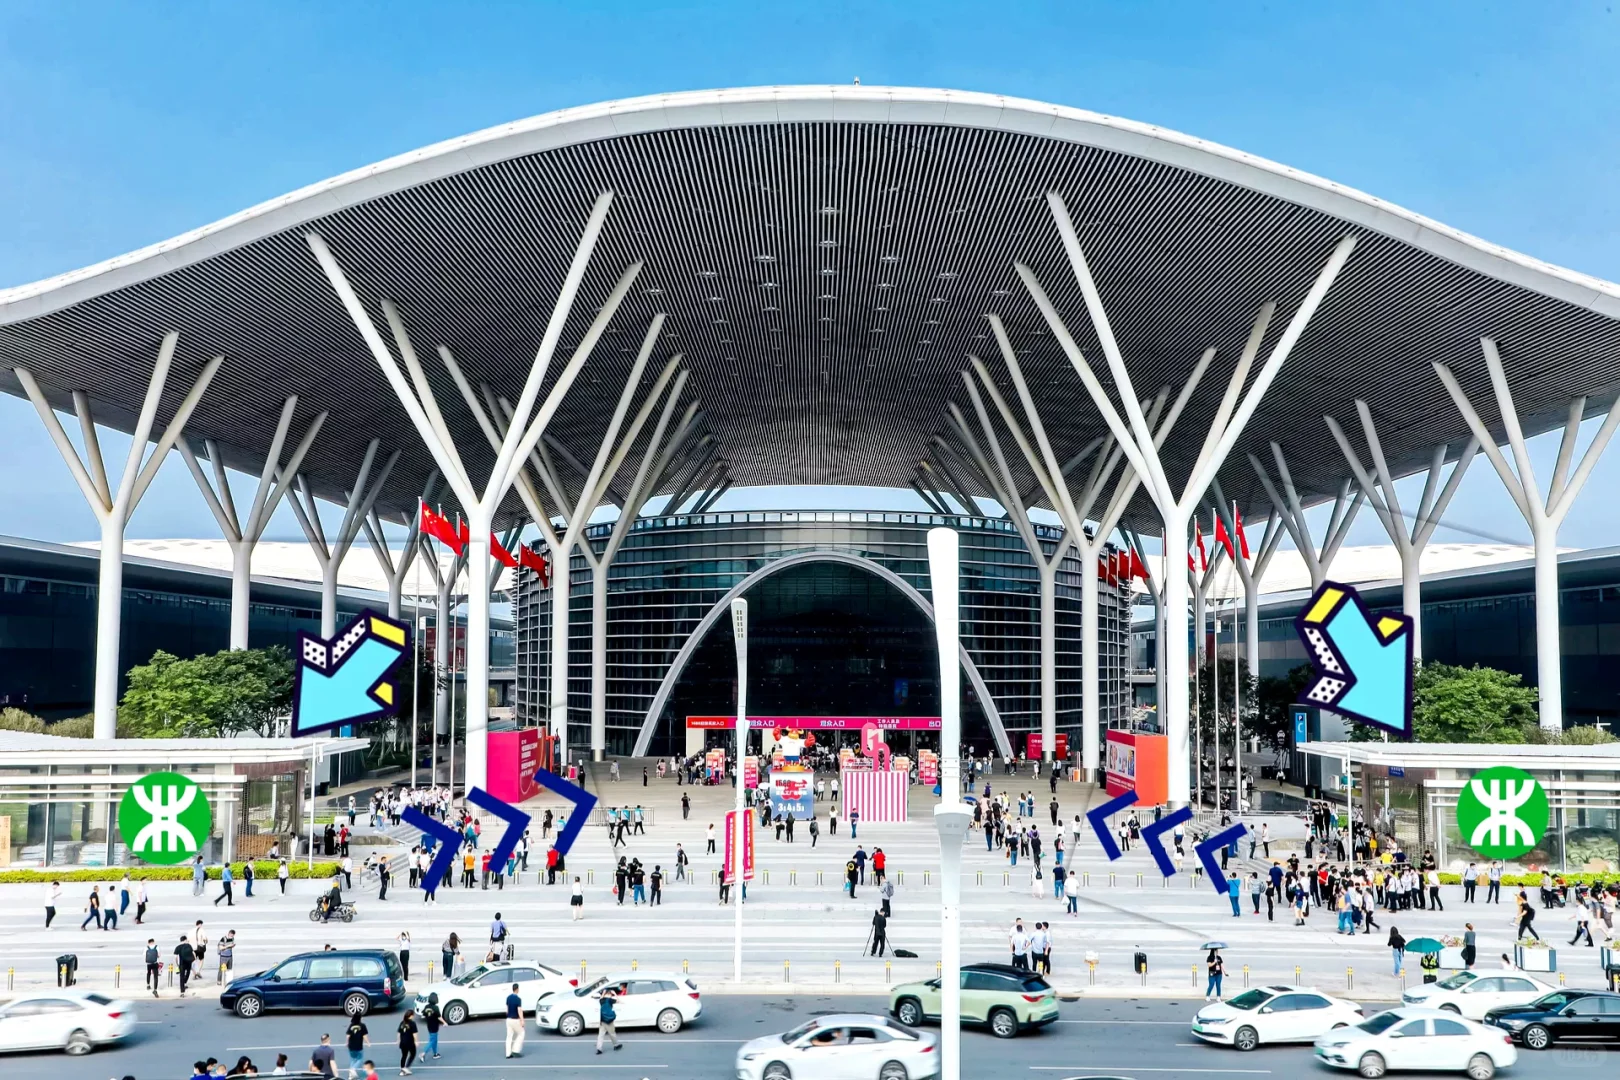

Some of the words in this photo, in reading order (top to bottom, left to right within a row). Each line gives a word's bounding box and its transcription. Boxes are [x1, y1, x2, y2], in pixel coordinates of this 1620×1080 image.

[820, 719, 845, 727] 观众入口
[928, 720, 941, 728] 出口
[1298, 723, 1303, 733] C
